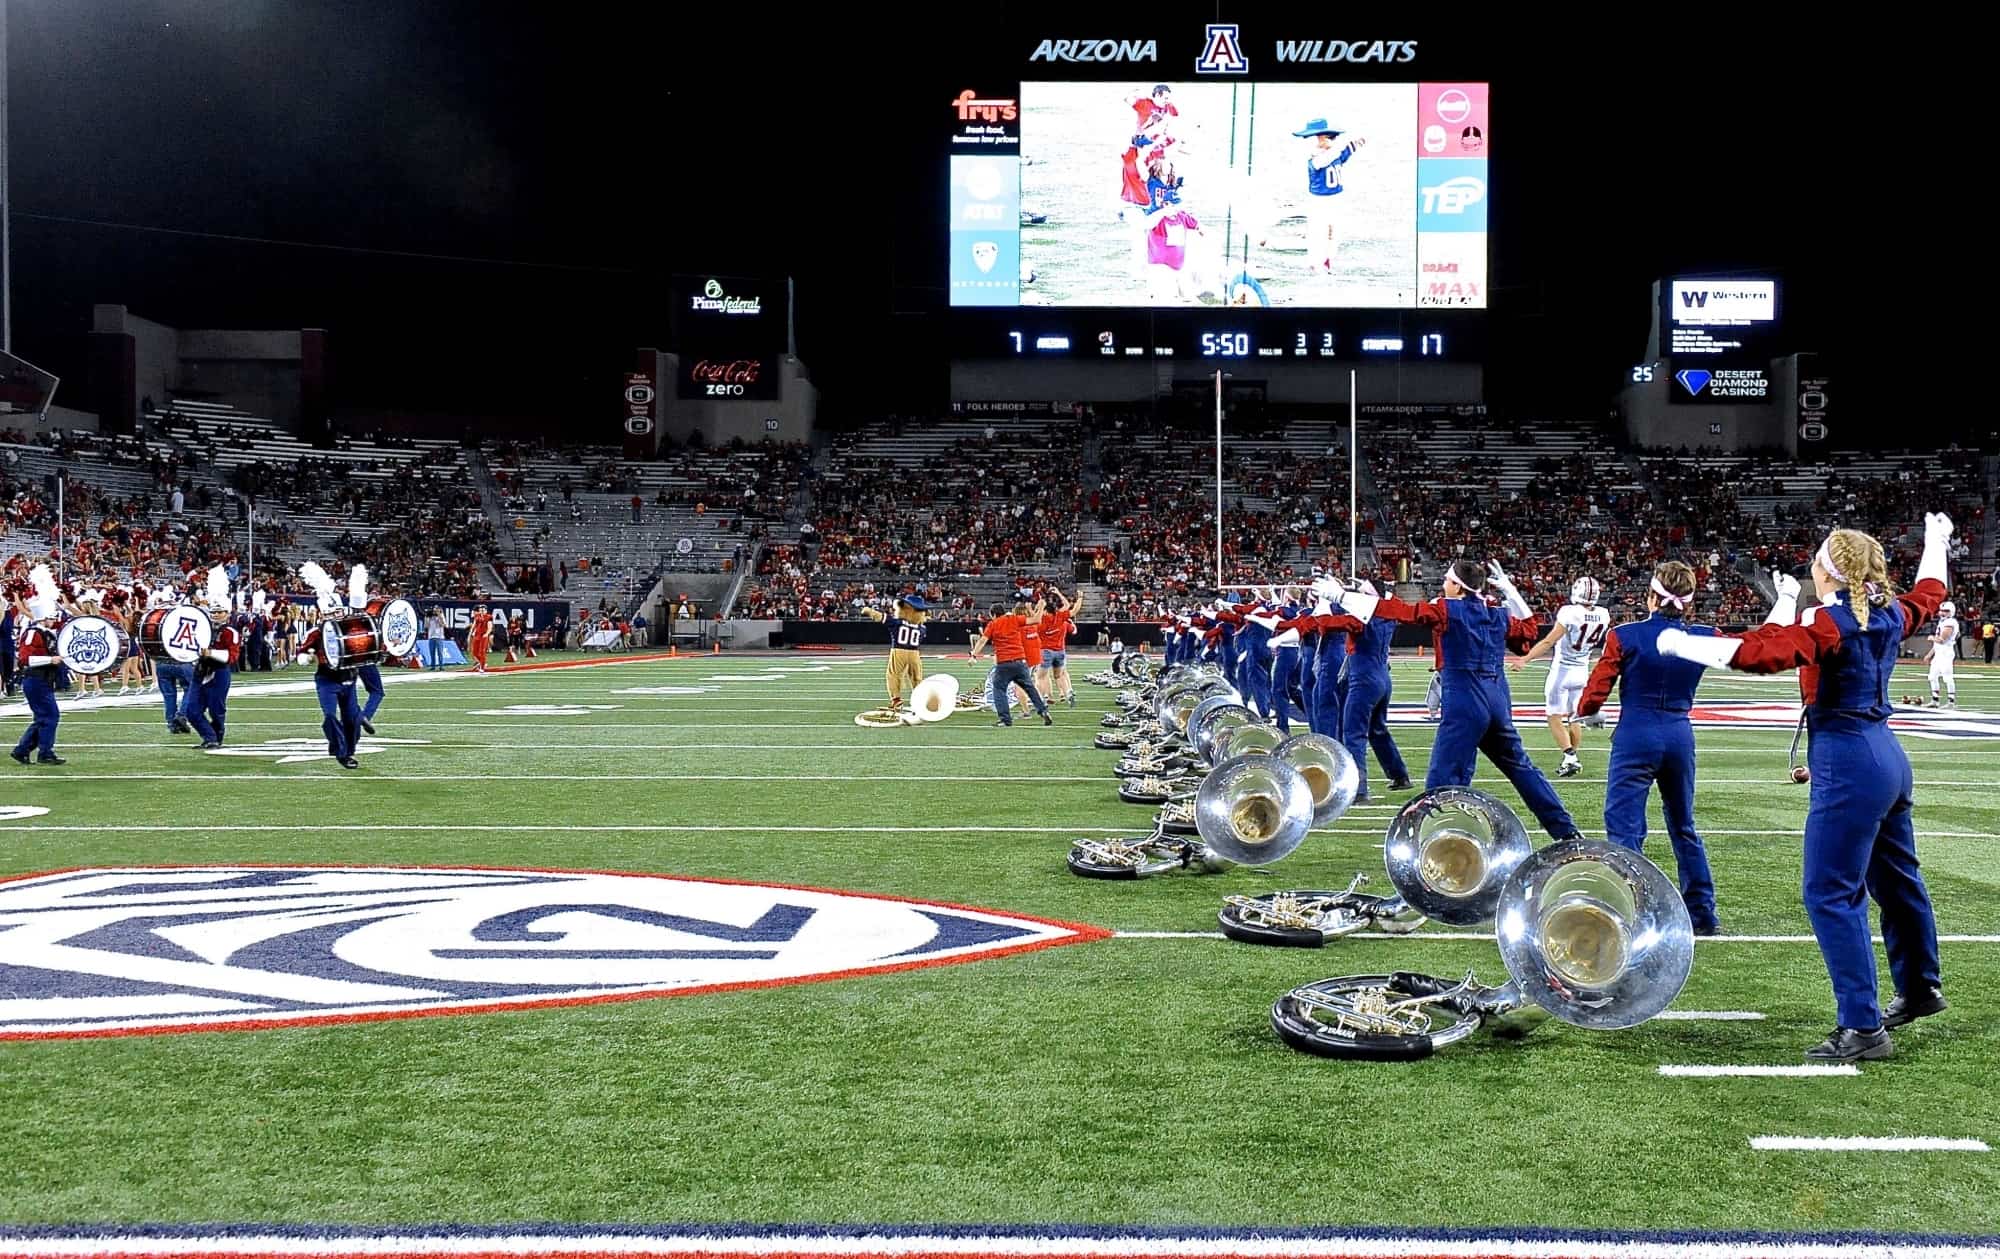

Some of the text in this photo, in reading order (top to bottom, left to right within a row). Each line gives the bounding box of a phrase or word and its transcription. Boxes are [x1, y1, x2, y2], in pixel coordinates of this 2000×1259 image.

[1029, 39, 1158, 62] ARIZONA
[1196, 24, 1249, 73] A
[1275, 40, 1418, 63] WILDCATS
[952, 89, 1017, 122] fry's
[1421, 177, 1484, 214] TEP
[1428, 281, 1482, 297] MAX
[1681, 291, 1709, 308] W
[1009, 332, 1022, 353] 7
[1202, 333, 1249, 356] 5:50
[1296, 333, 1306, 347] 3
[1323, 333, 1332, 347] 3
[1422, 334, 1442, 355] 17
[1633, 366, 1653, 381] 25
[1715, 370, 1763, 379] DESERT
[706, 384, 744, 395] zero
[1709, 378, 1769, 388] DIAMOND
[1711, 388, 1767, 396] CASINOS
[967, 403, 989, 411] FOLK
[991, 403, 1026, 411] HEROES
[766, 420, 778, 430] 10
[1710, 424, 1721, 433] 14
[169, 616, 200, 652] A
[897, 625, 921, 647] 00
[1572, 623, 1604, 652] 14
